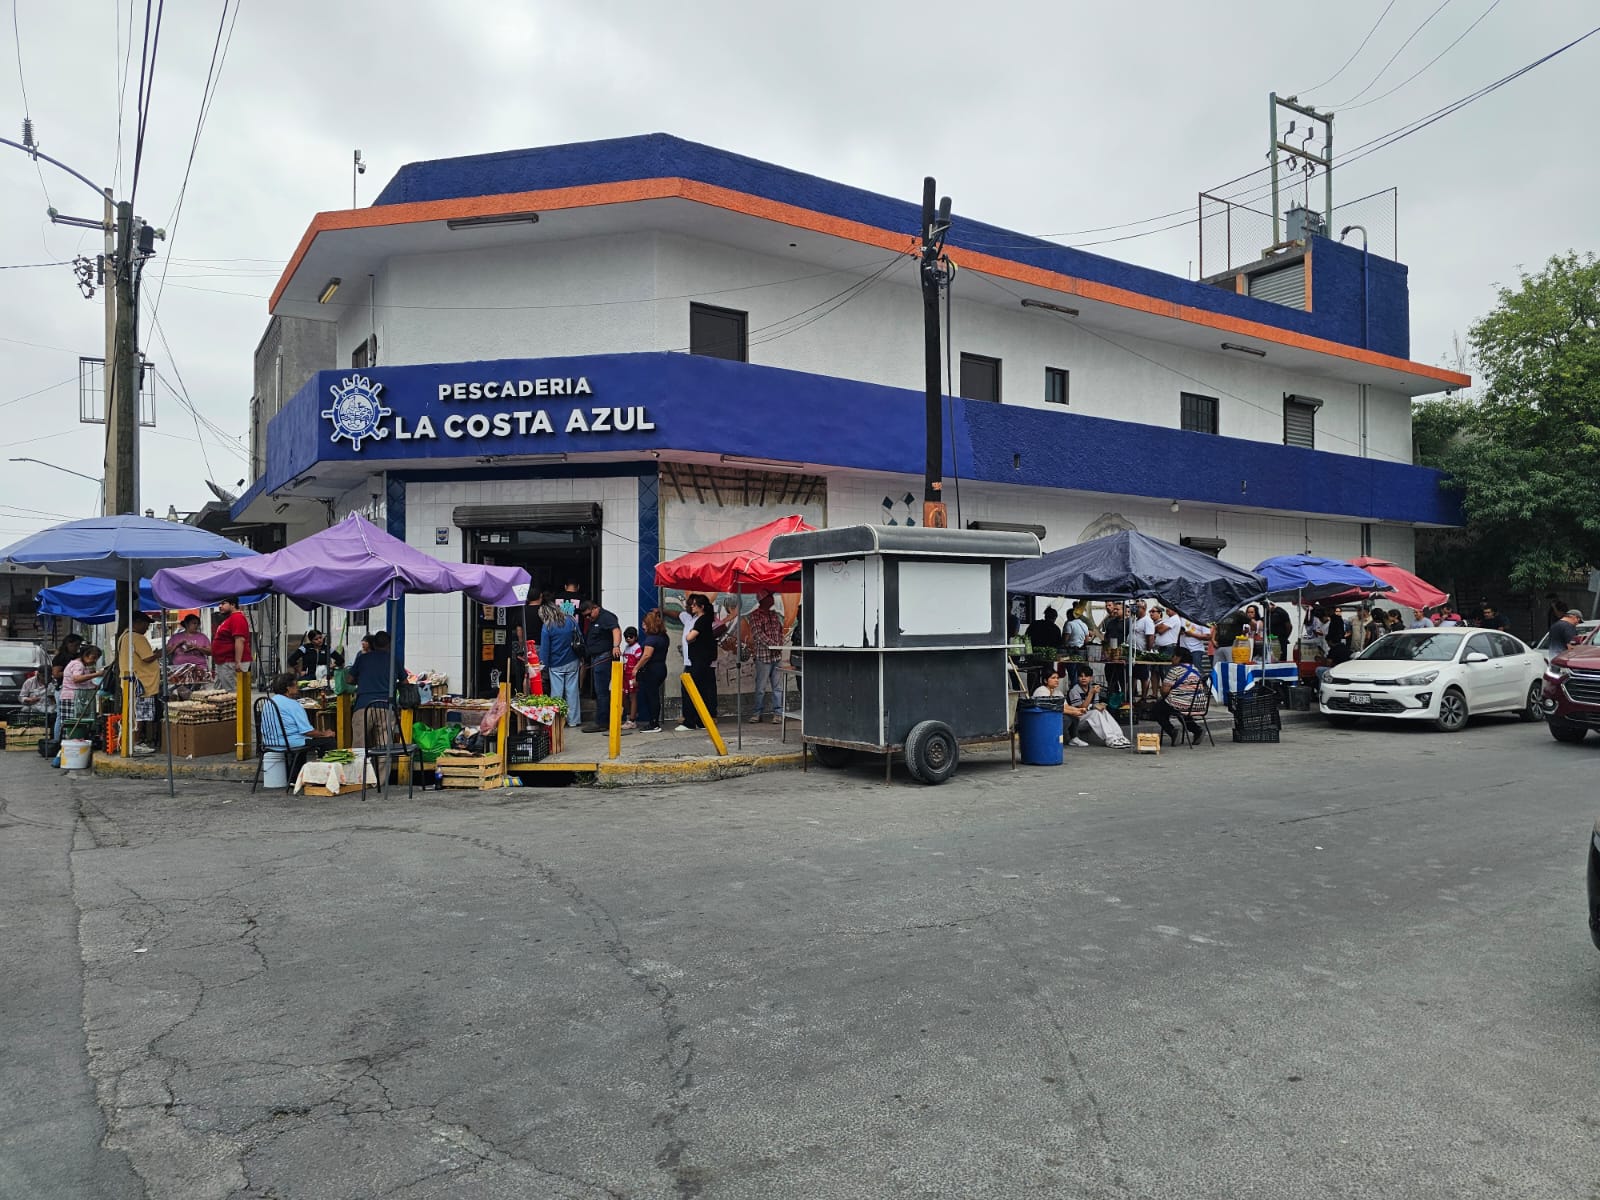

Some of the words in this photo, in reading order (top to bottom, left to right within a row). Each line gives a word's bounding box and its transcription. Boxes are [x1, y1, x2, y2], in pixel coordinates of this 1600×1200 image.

[438, 377, 592, 401] PESCADERIA
[394, 414, 438, 440] LA
[444, 409, 554, 439] COSTA
[565, 406, 656, 432] AZUL
